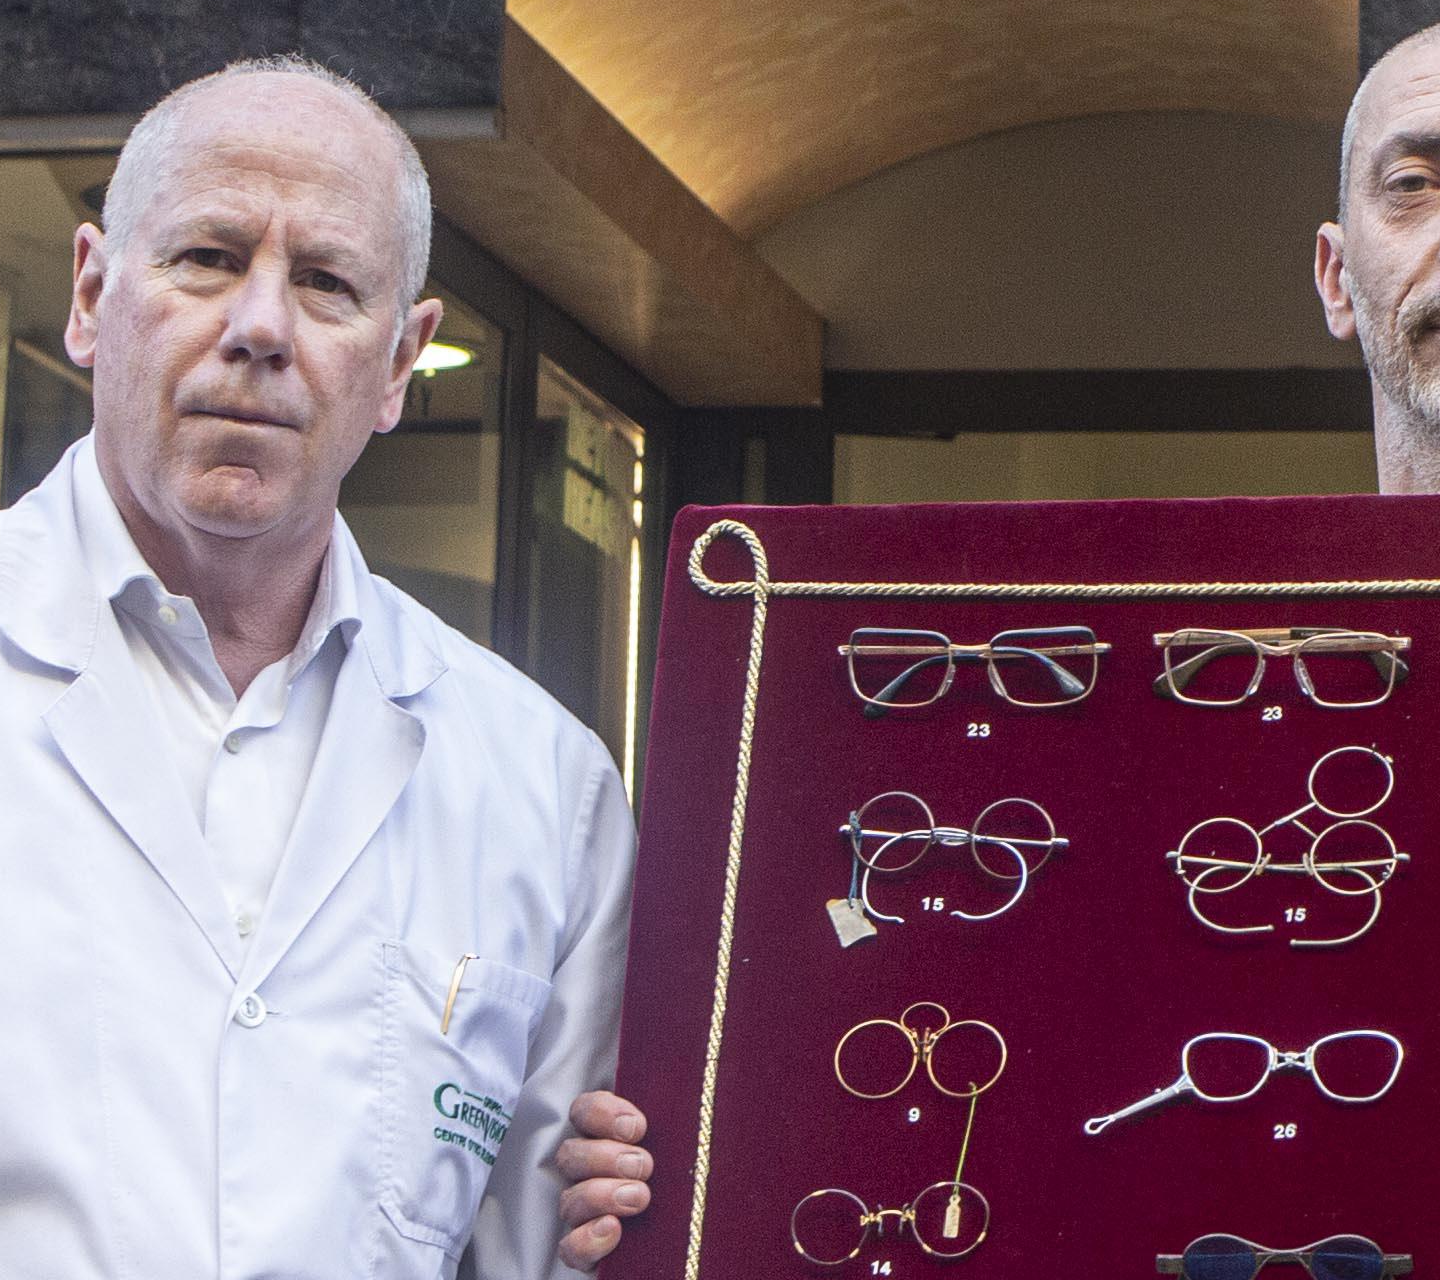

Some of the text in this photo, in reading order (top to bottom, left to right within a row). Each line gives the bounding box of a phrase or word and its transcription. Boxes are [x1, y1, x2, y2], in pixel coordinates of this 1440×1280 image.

[1261, 705, 1283, 722] 23
[966, 722, 991, 738] 23
[921, 896, 945, 912] 15
[1284, 907, 1307, 923] 15
[907, 1106, 921, 1123] 9
[1273, 1122, 1298, 1140] 26
[870, 1259, 893, 1276] 14
